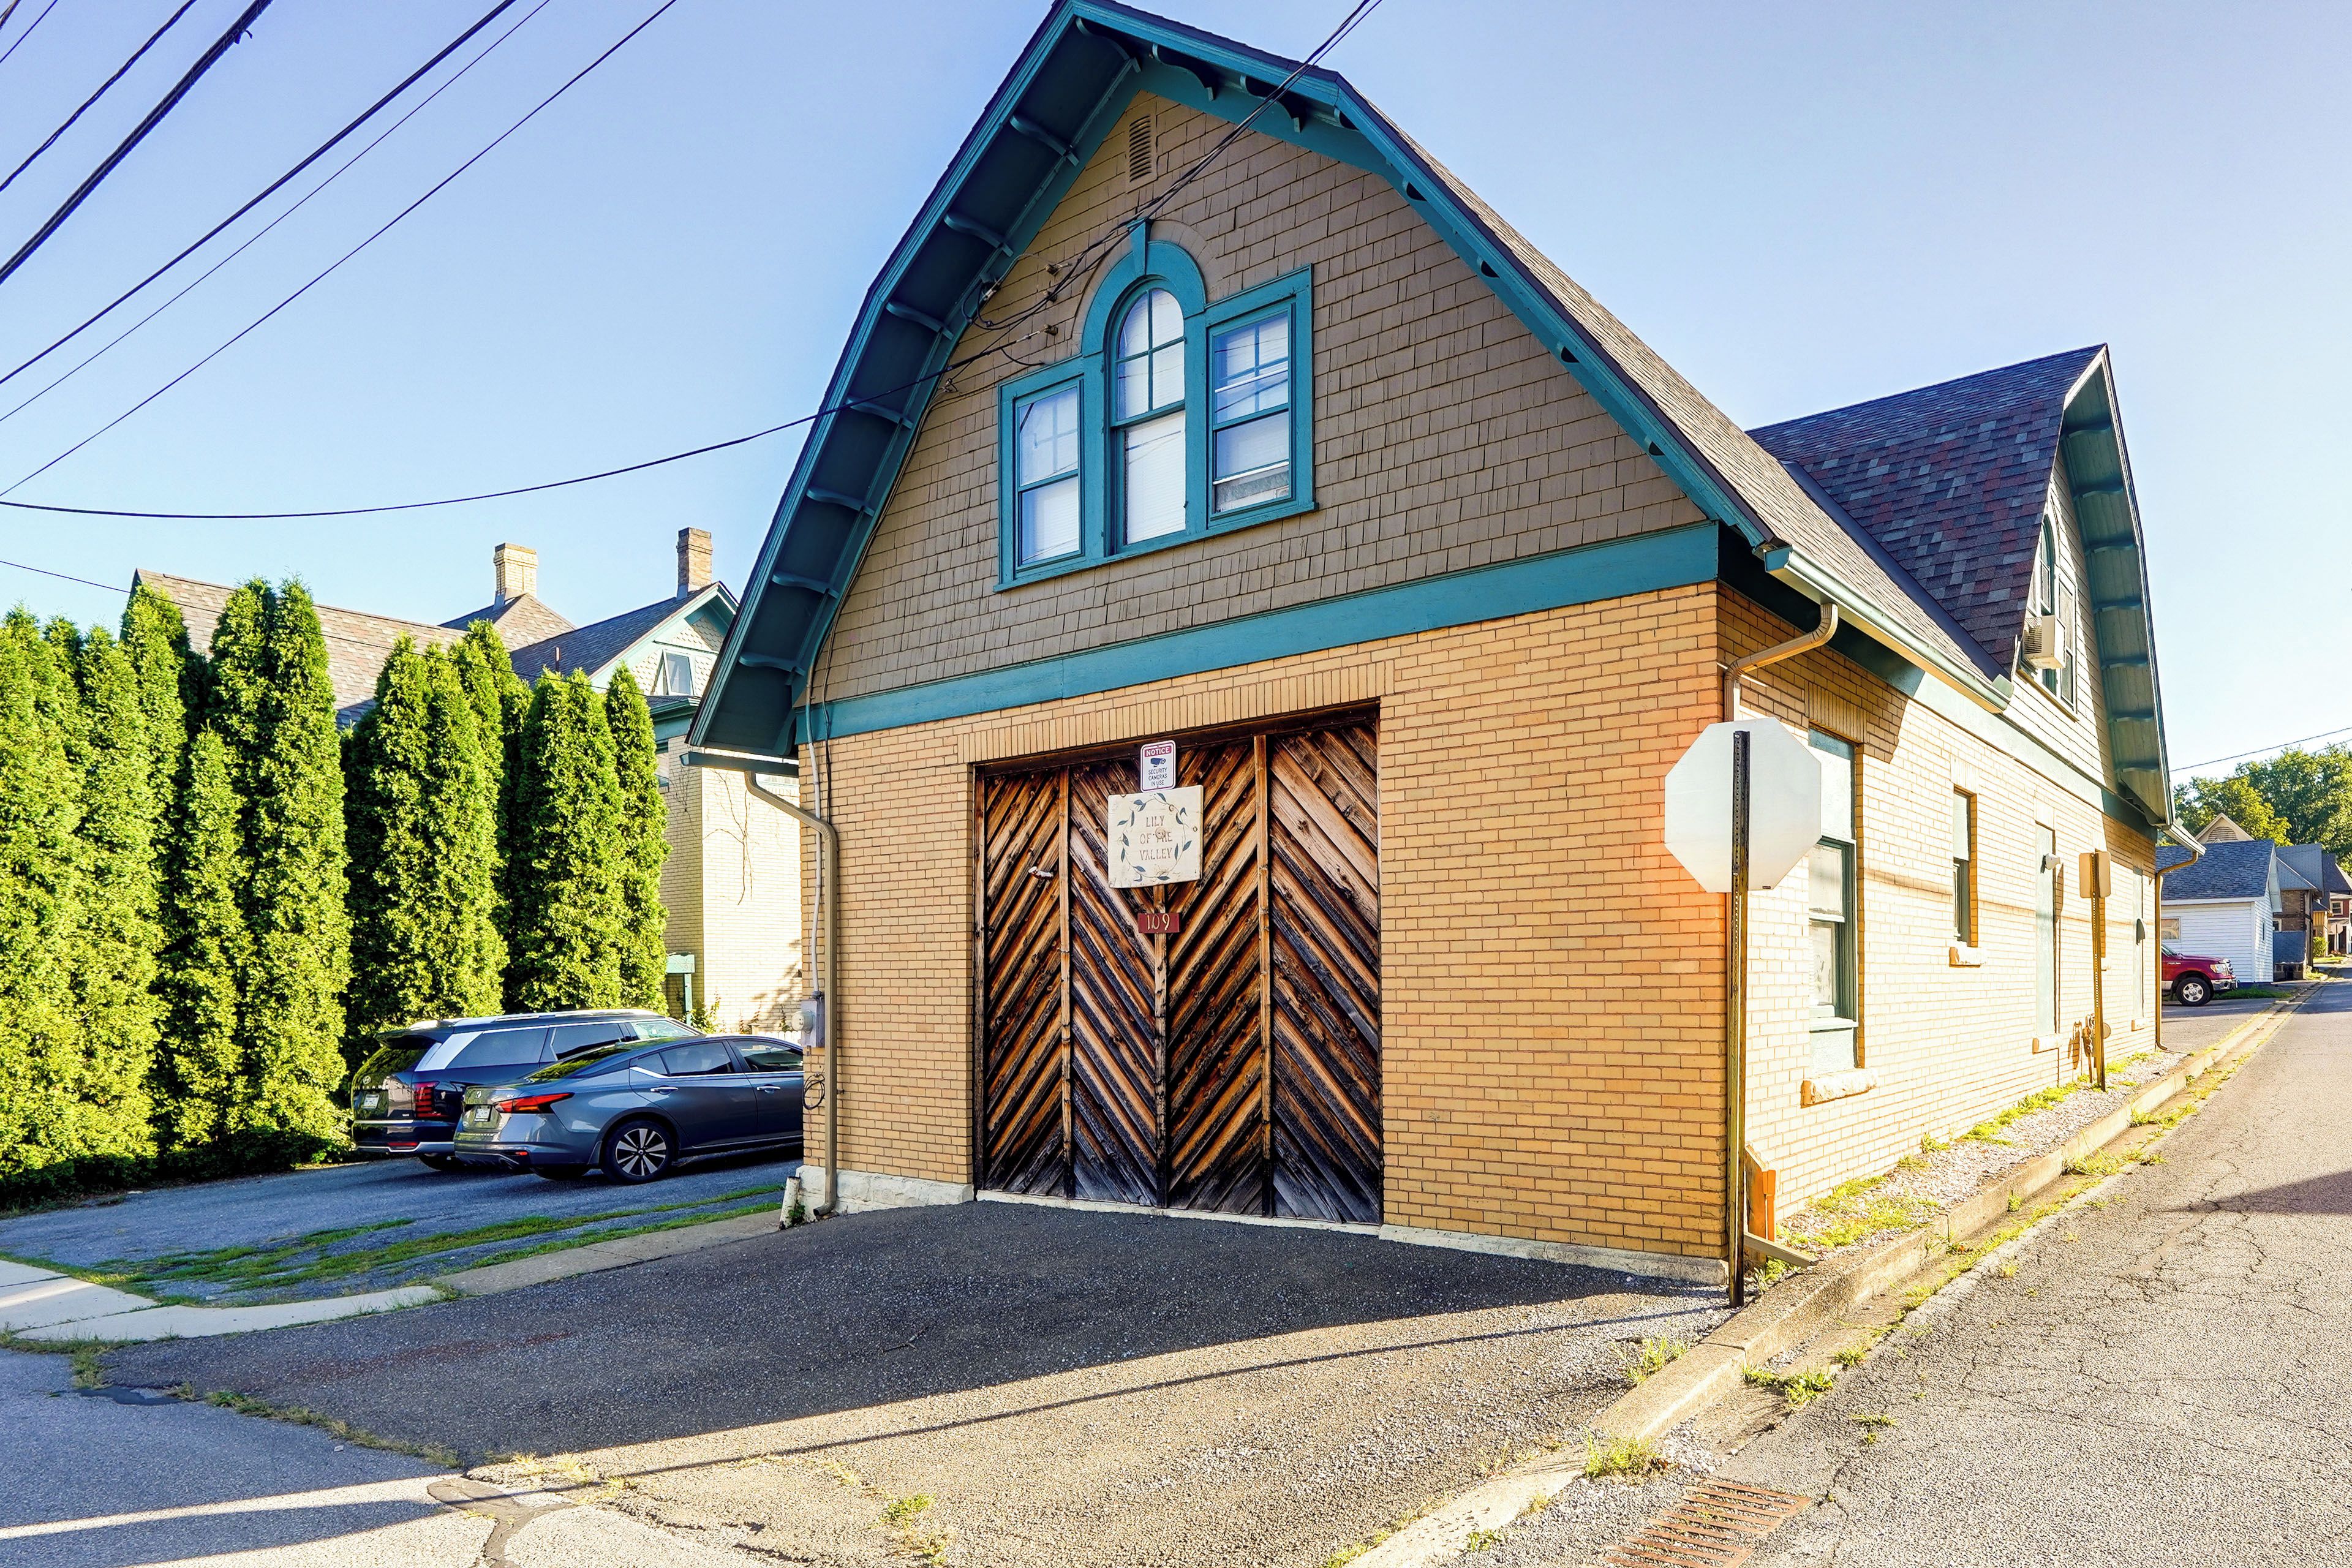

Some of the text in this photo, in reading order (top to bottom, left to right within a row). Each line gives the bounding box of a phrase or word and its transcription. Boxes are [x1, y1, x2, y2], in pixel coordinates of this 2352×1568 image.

[1146, 747, 1170, 756] NOTICE
[1146, 815, 1165, 827] LILY
[1140, 833, 1152, 845] OF
[1139, 847, 1172, 861] VALLEY
[1147, 913, 1170, 931] 109
